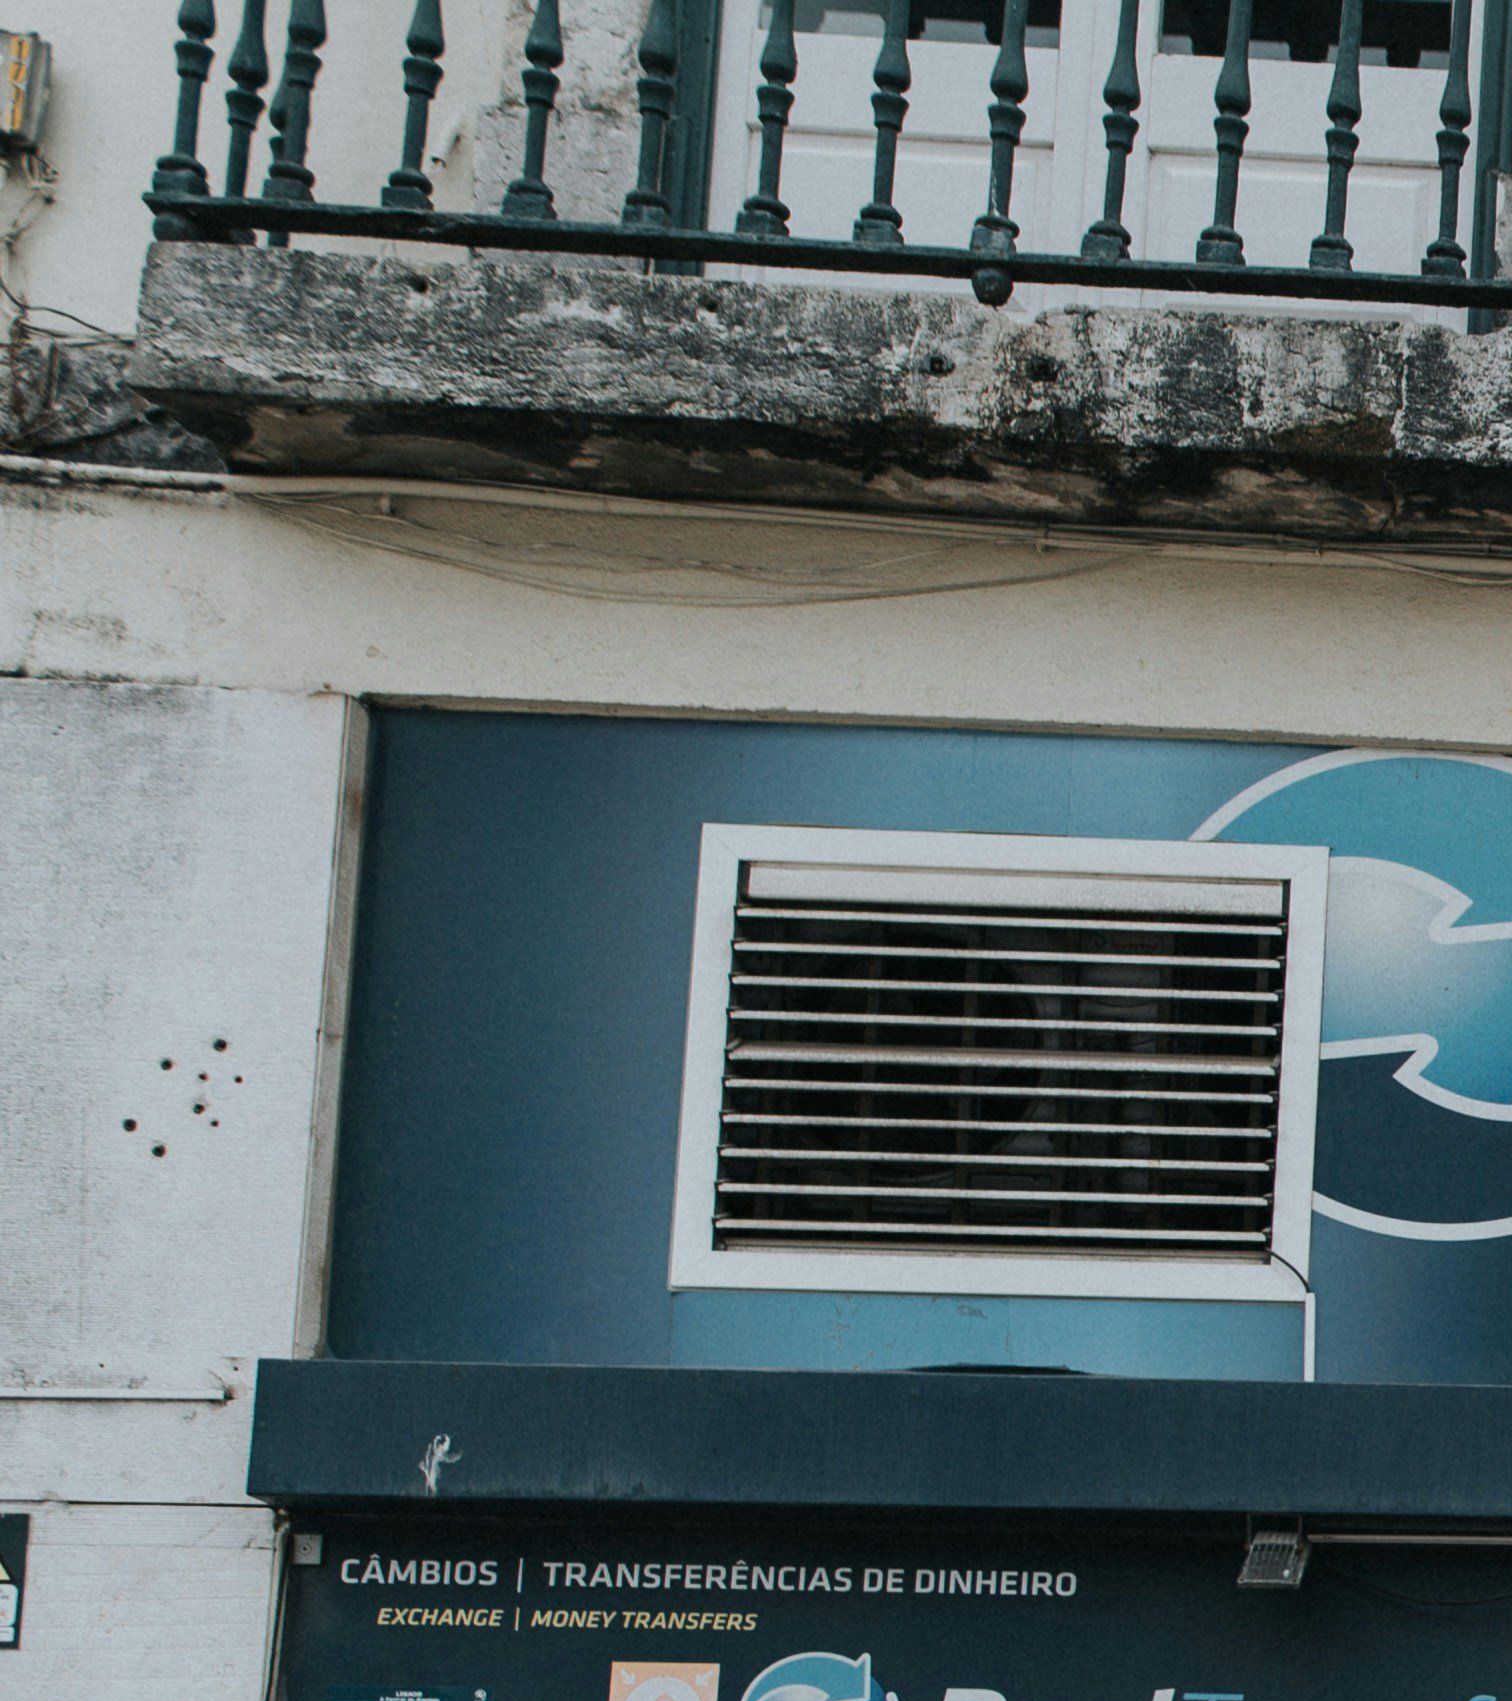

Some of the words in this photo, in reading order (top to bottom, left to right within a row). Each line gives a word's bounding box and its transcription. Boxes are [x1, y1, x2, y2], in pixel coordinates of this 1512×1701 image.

[340, 1553, 498, 1585] CÂMBIOS
[543, 1556, 852, 1593] TRANSFERÊNCIAS
[862, 1567, 905, 1593] DE
[914, 1568, 1077, 1596] DINHEIRO
[376, 1607, 504, 1627] EXCHANGE
[530, 1609, 617, 1628] MONEY
[622, 1610, 758, 1631] TRANSFERS
